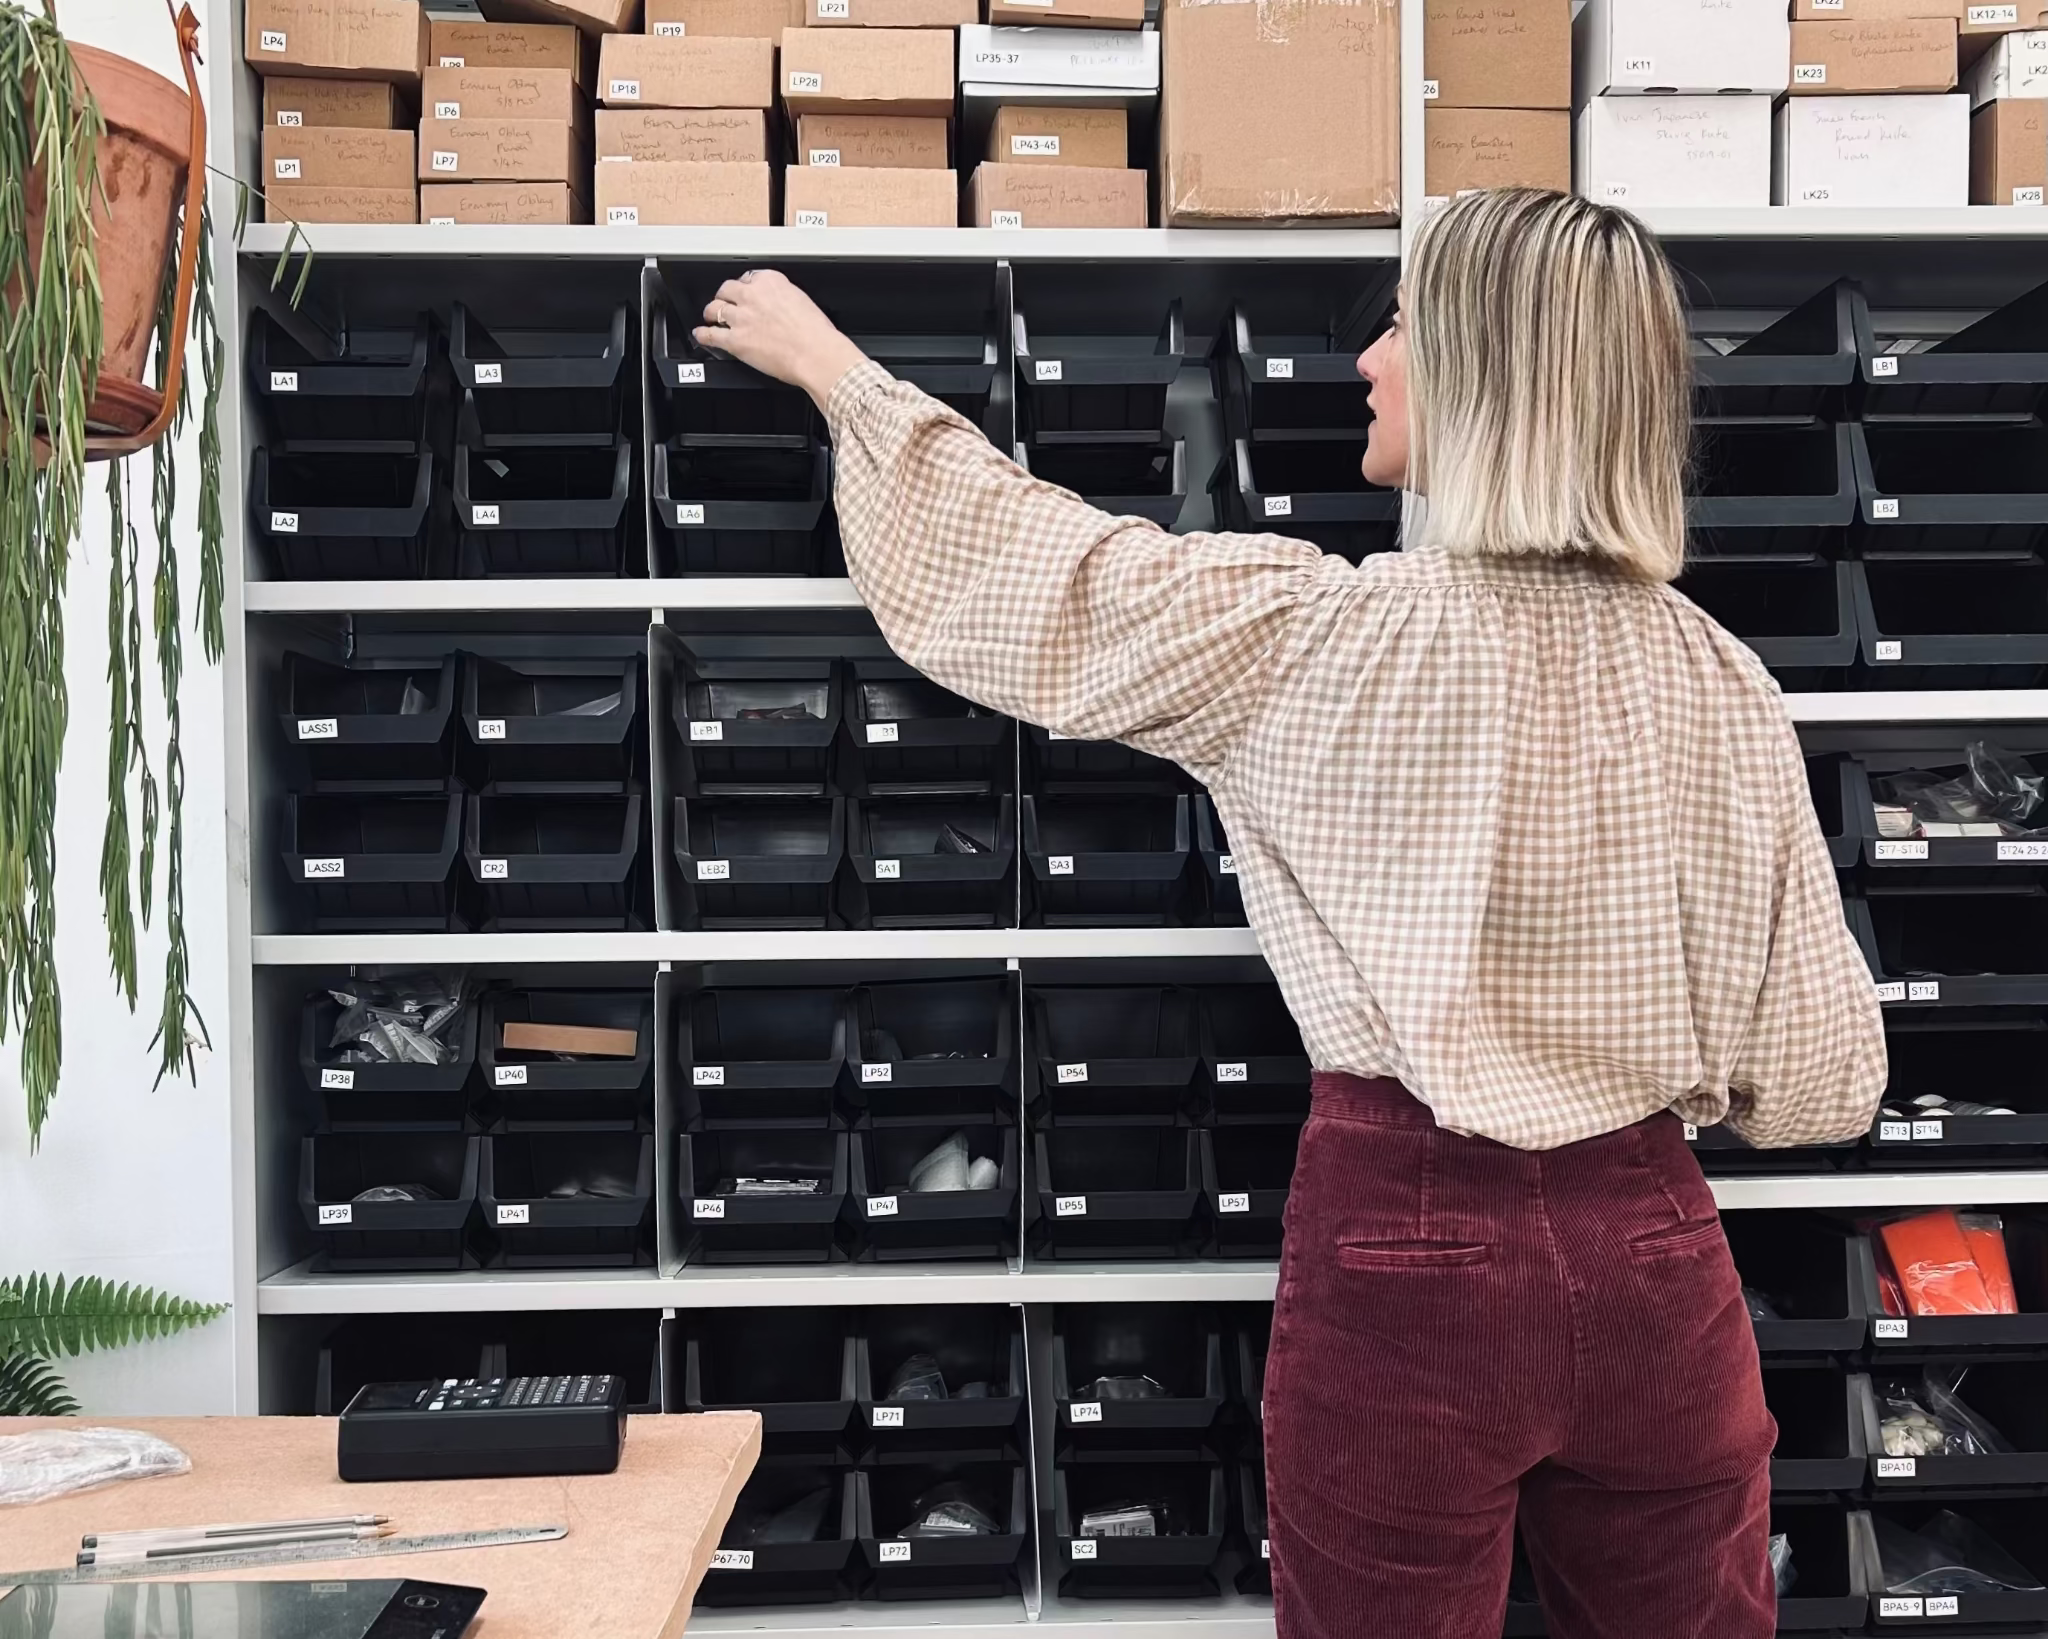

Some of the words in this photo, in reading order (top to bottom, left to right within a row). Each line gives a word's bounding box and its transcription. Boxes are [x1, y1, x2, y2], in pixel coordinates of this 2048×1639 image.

[819, 3, 847, 13] LP21
[1969, 7, 2015, 20] LK12-14
[656, 25, 682, 37] LP19
[263, 35, 284, 47] LP4
[975, 52, 1020, 64] LP35-37
[1625, 60, 1652, 71] LK11
[1796, 68, 1823, 78] LK23
[792, 76, 819, 88] LP28
[611, 84, 637, 95] LP18
[437, 106, 458, 117] LP6
[279, 115, 301, 126] LP3
[1013, 139, 1057, 151] LP43-45
[434, 156, 456, 167] LP7
[811, 153, 838, 164] LP20
[277, 163, 297, 174] LP1
[1606, 186, 1627, 197] LK9
[1802, 189, 1829, 201] LK25
[2014, 190, 2041, 202] LK28
[609, 211, 636, 221] LP16
[798, 214, 825, 226] LP26
[993, 215, 1019, 226] LP61
[1038, 365, 1060, 376] LA9
[1268, 362, 1290, 374] SG1
[1875, 360, 1895, 372] LB1
[477, 368, 499, 379] LA3
[681, 367, 702, 379] LA5
[273, 375, 295, 387] LA1
[1267, 500, 1288, 512] SG2
[1875, 503, 1896, 514] LB2
[475, 509, 497, 520] LA4
[679, 509, 701, 520] LA6
[274, 516, 296, 529] LA2
[301, 723, 335, 735] LASS1
[481, 723, 503, 735] CR1
[871, 727, 896, 738] B3
[1999, 845, 2024, 856] ST24
[2026, 845, 2040, 856] 25
[2041, 845, 2048, 856] 2
[307, 862, 342, 874] LASS2
[483, 863, 505, 875] CR2
[700, 864, 727, 875] LEB2
[877, 864, 897, 874] SA1
[1050, 860, 1070, 870] SA3
[1877, 986, 1902, 997] ST11
[1911, 985, 1937, 997] ST12
[497, 1069, 525, 1081] LP40
[695, 1070, 721, 1081] LP42
[863, 1067, 890, 1078] LP52
[1059, 1067, 1085, 1079] LP54
[1218, 1067, 1245, 1078] LP56
[324, 1073, 351, 1085] LP38
[1882, 1124, 1908, 1137] ST13
[1914, 1123, 1940, 1136] ST14
[696, 1203, 722, 1214] LP46
[869, 1200, 895, 1212] LP47
[1058, 1199, 1084, 1211] LP55
[1220, 1197, 1247, 1208] LP57
[321, 1208, 349, 1220] LP39
[500, 1208, 527, 1220] LP41
[1877, 1323, 1905, 1335] BPA3
[874, 1410, 901, 1423] LP71
[1072, 1405, 1099, 1419] LP74
[1880, 1462, 1913, 1473] BPA10
[881, 1544, 909, 1558] LP72
[1073, 1543, 1096, 1556] SC2
[711, 1553, 751, 1565] P67-70
[1928, 1600, 1956, 1611] BPA4
